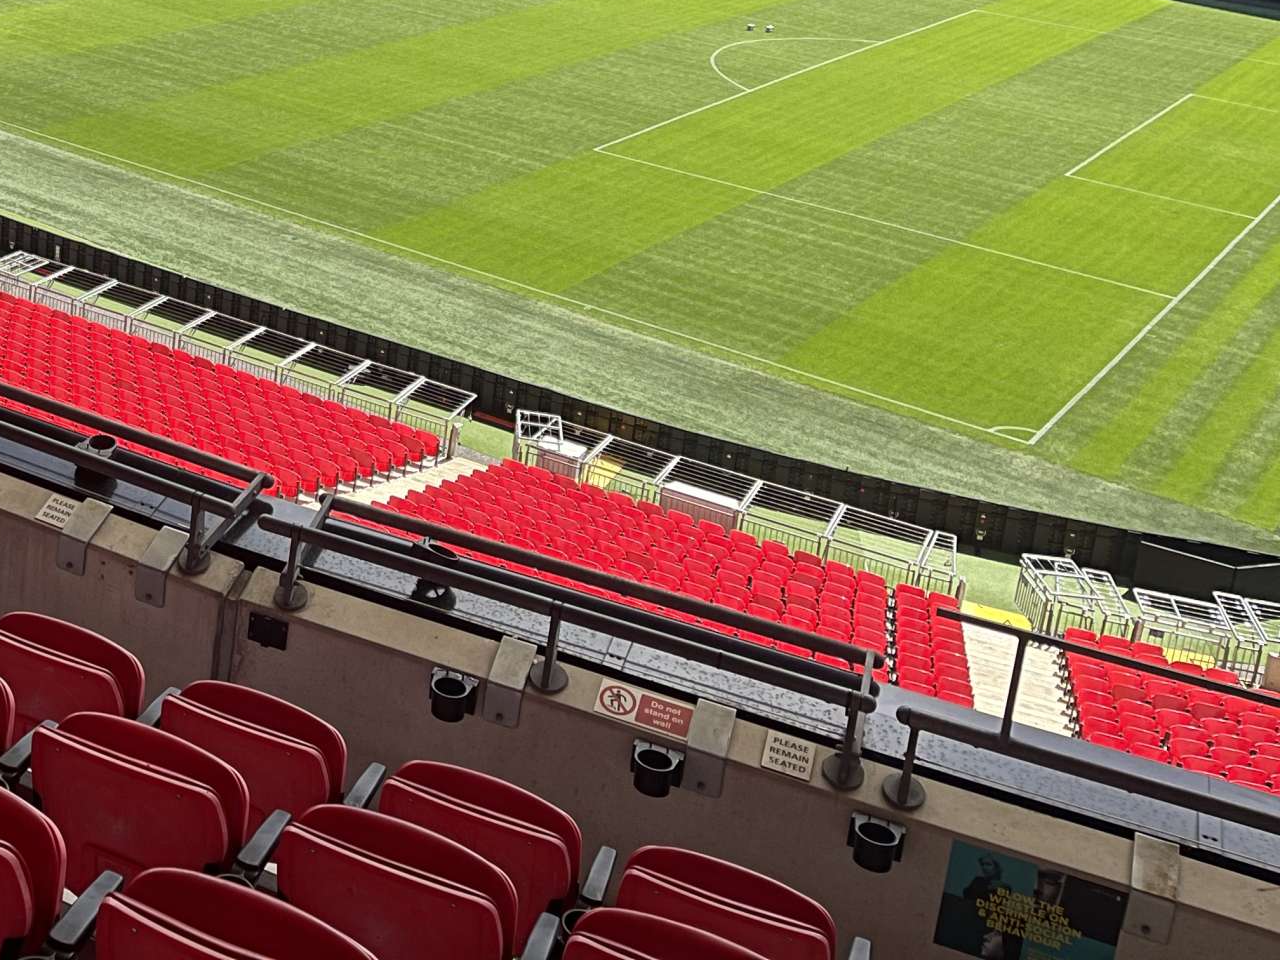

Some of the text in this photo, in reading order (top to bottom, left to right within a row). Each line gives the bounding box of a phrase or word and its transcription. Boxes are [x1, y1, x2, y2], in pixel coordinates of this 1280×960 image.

[46, 503, 72, 517] REMAIN
[52, 497, 76, 510] PLEASE
[42, 511, 66, 523] SEATED
[644, 707, 684, 725] stand on
[650, 700, 681, 717] Do not
[652, 717, 671, 729] wall
[773, 736, 810, 754] PLEASE
[770, 746, 810, 764] REMAIN
[769, 755, 806, 774] SEATED
[989, 893, 1070, 926] WHISTLE ON
[996, 887, 1065, 915] BLOW THE
[976, 898, 1082, 938] DISCRIMINATION
[977, 908, 1073, 945] & ANTI-SOCIAL
[986, 919, 1063, 951] BEHAVIOUR
